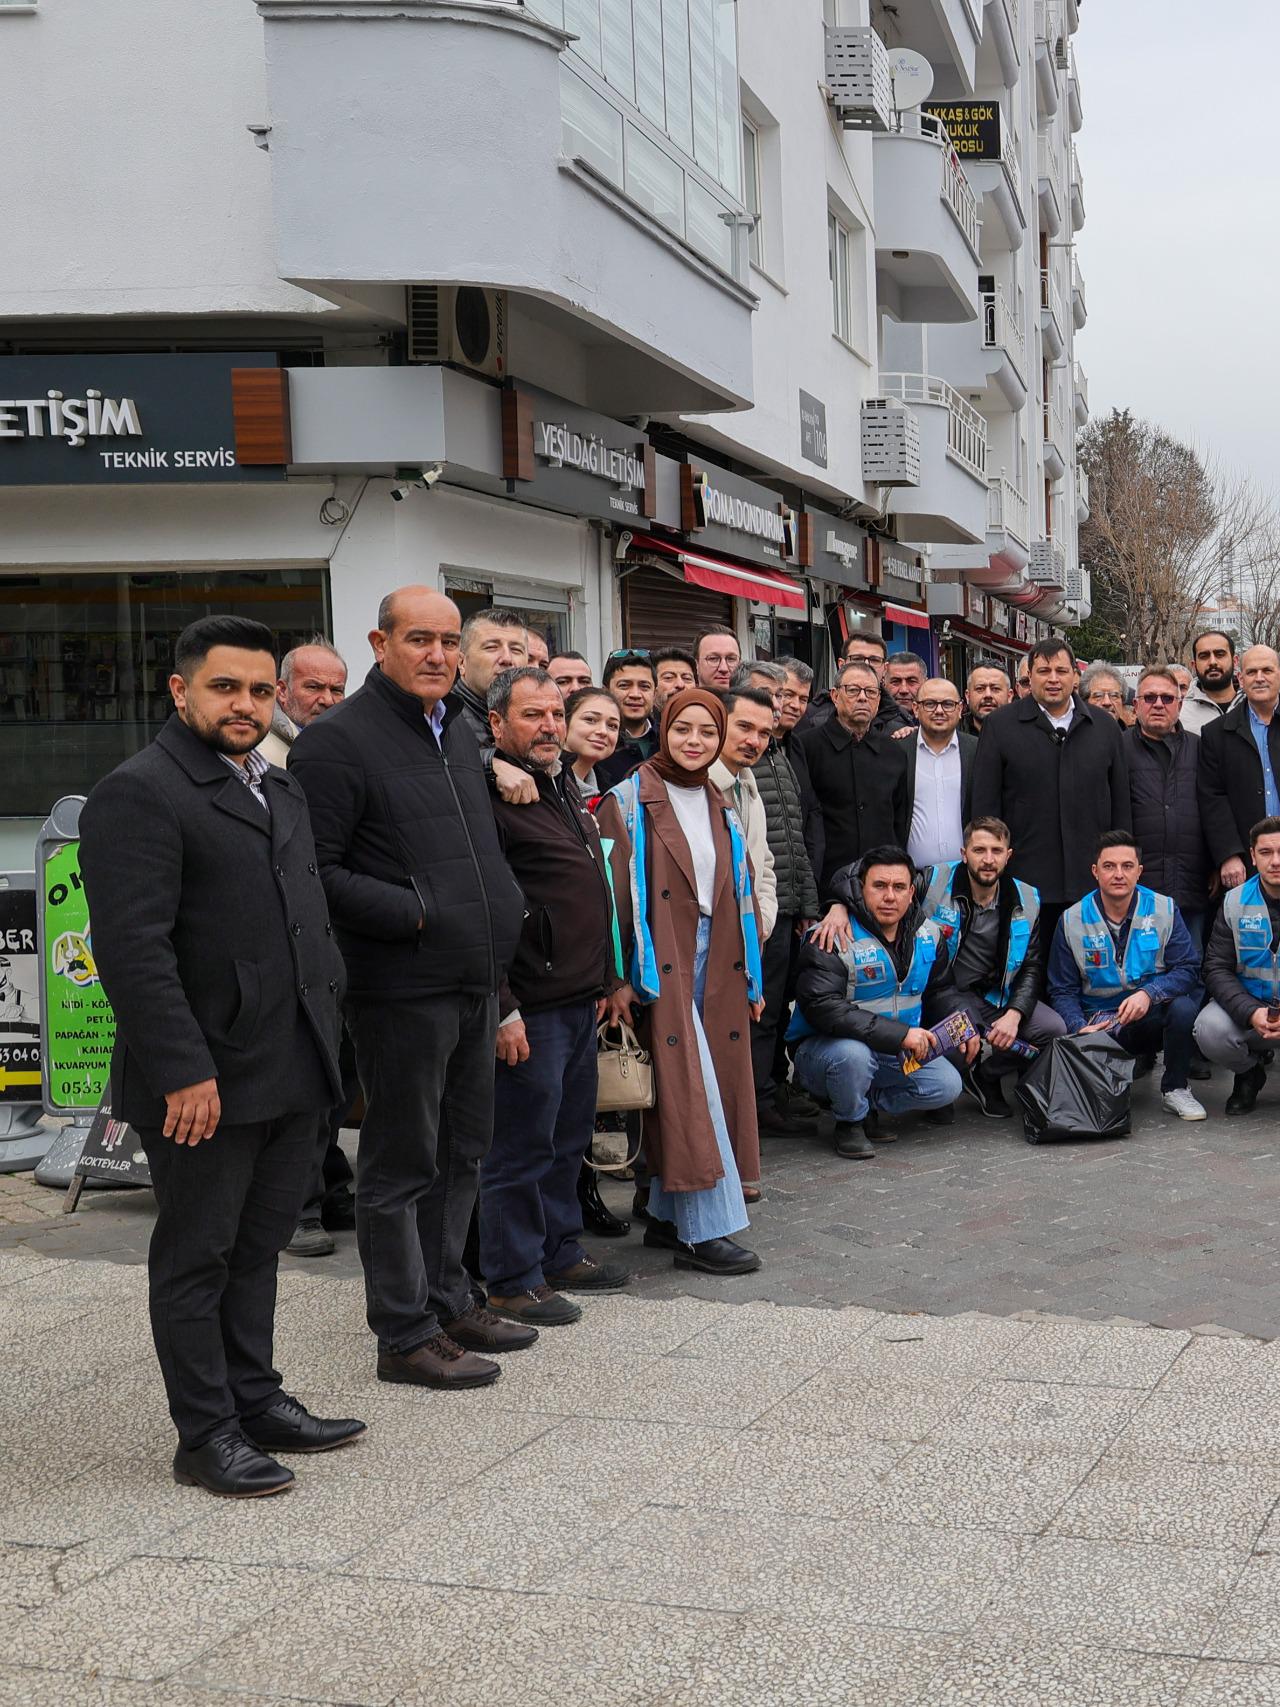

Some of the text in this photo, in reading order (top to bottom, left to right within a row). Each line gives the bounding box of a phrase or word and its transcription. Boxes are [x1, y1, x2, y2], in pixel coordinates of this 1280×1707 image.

[953, 140, 984, 152] ROSU
[100, 446, 235, 468] TEKNİK SERVİS
[541, 421, 645, 491] YEŞİLDAĞ İLETİŞİM
[609, 496, 638, 515] TEKNİK SERVİS
[705, 486, 785, 543] ROMA DONDURMA
[86, 1015, 103, 1024] PET
[55, 1029, 99, 1040] PAPAĞAN
[12, 1048, 28, 1063] 04
[30, 1048, 42, 1064] 0
[54, 1061, 106, 1070] AKVARYUM
[61, 1081, 102, 1094] 0533
[79, 1155, 131, 1171] KOKTEYLLER
